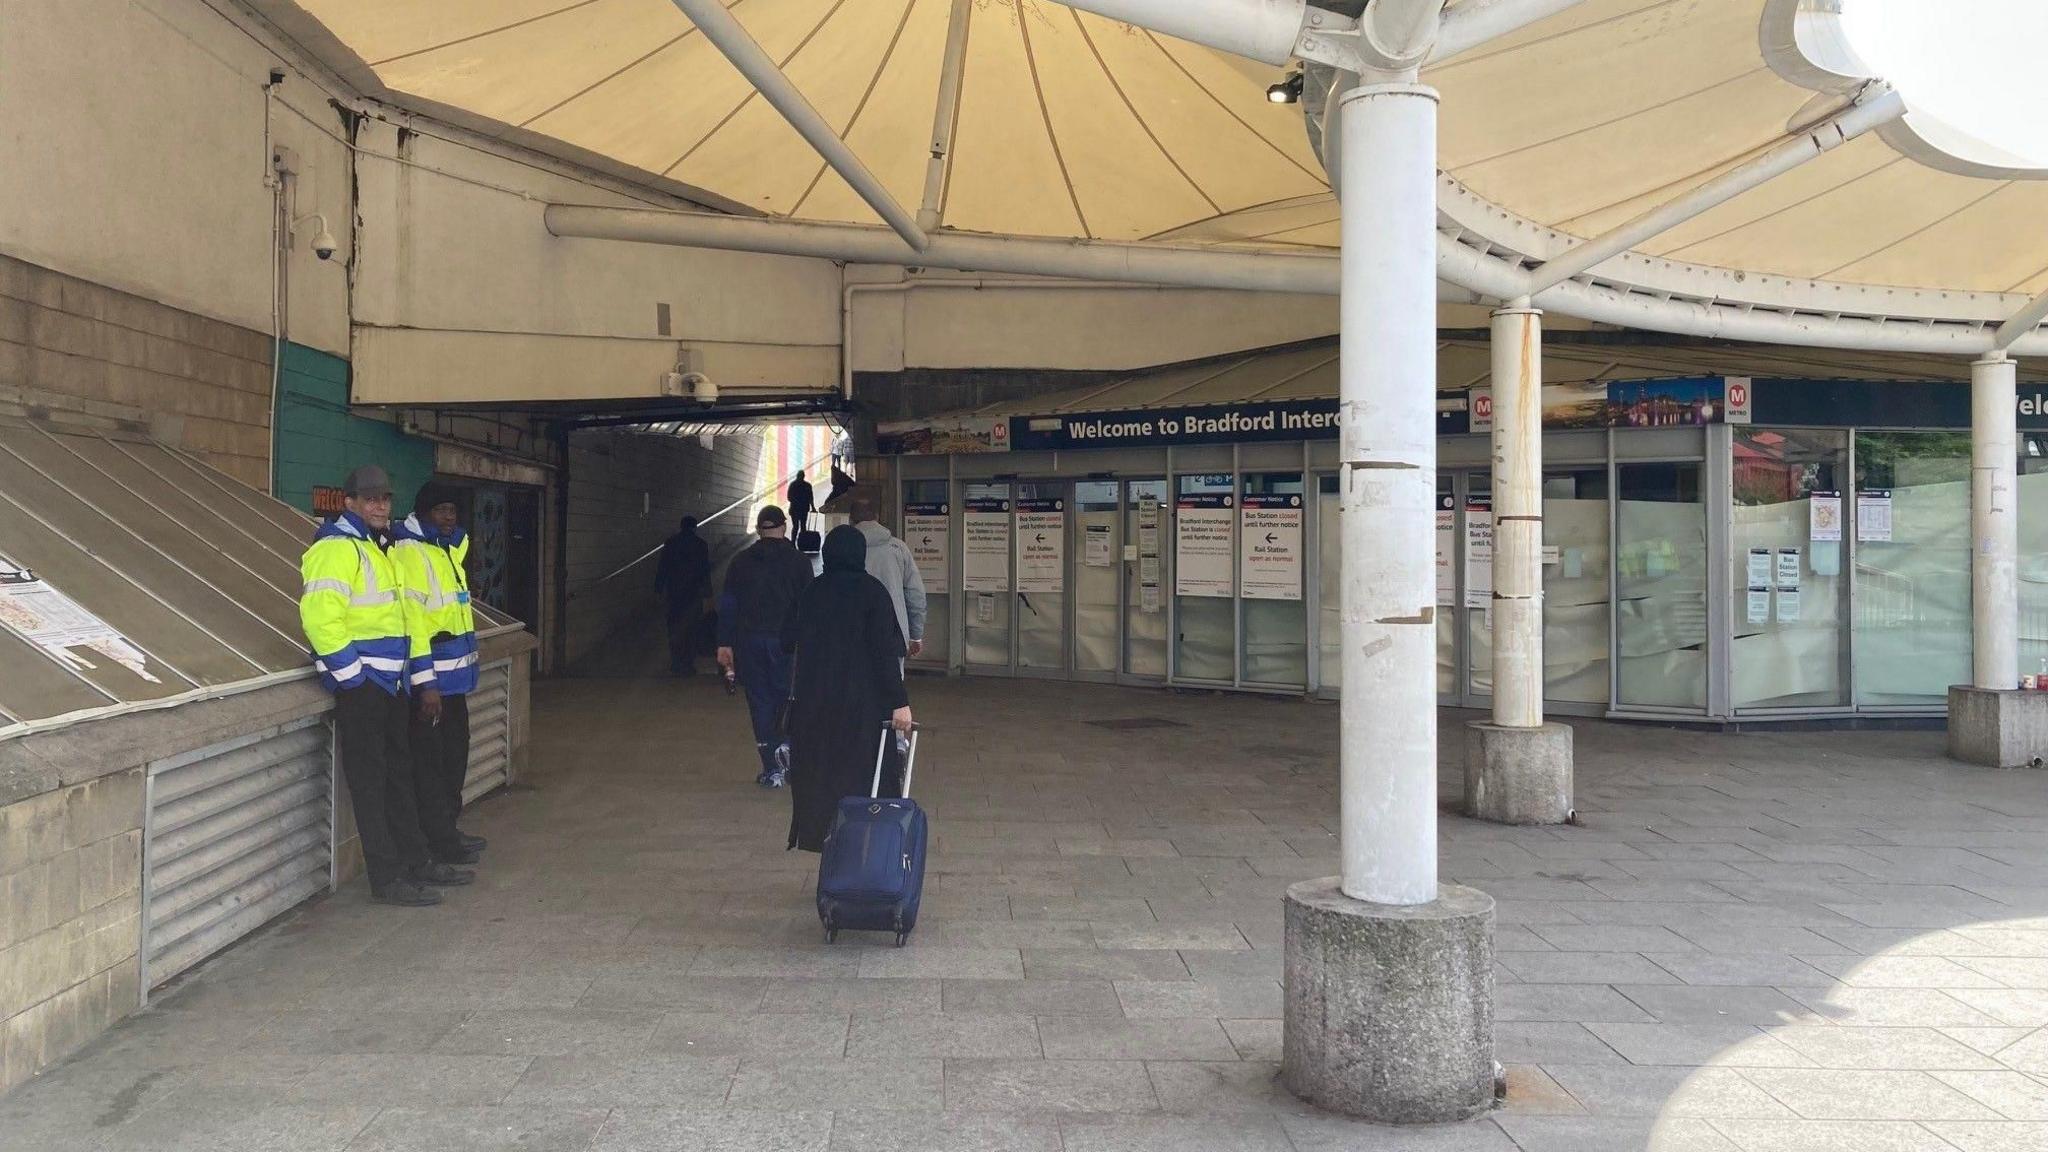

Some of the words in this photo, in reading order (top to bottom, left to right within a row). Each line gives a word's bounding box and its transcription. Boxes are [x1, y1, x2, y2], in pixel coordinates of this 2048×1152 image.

[1069, 418, 1152, 440] Welcome
[1158, 416, 1179, 435] to
[1185, 411, 1275, 434] Bradford
[1281, 409, 1341, 429] Interc
[1266, 545, 1288, 553] Station
